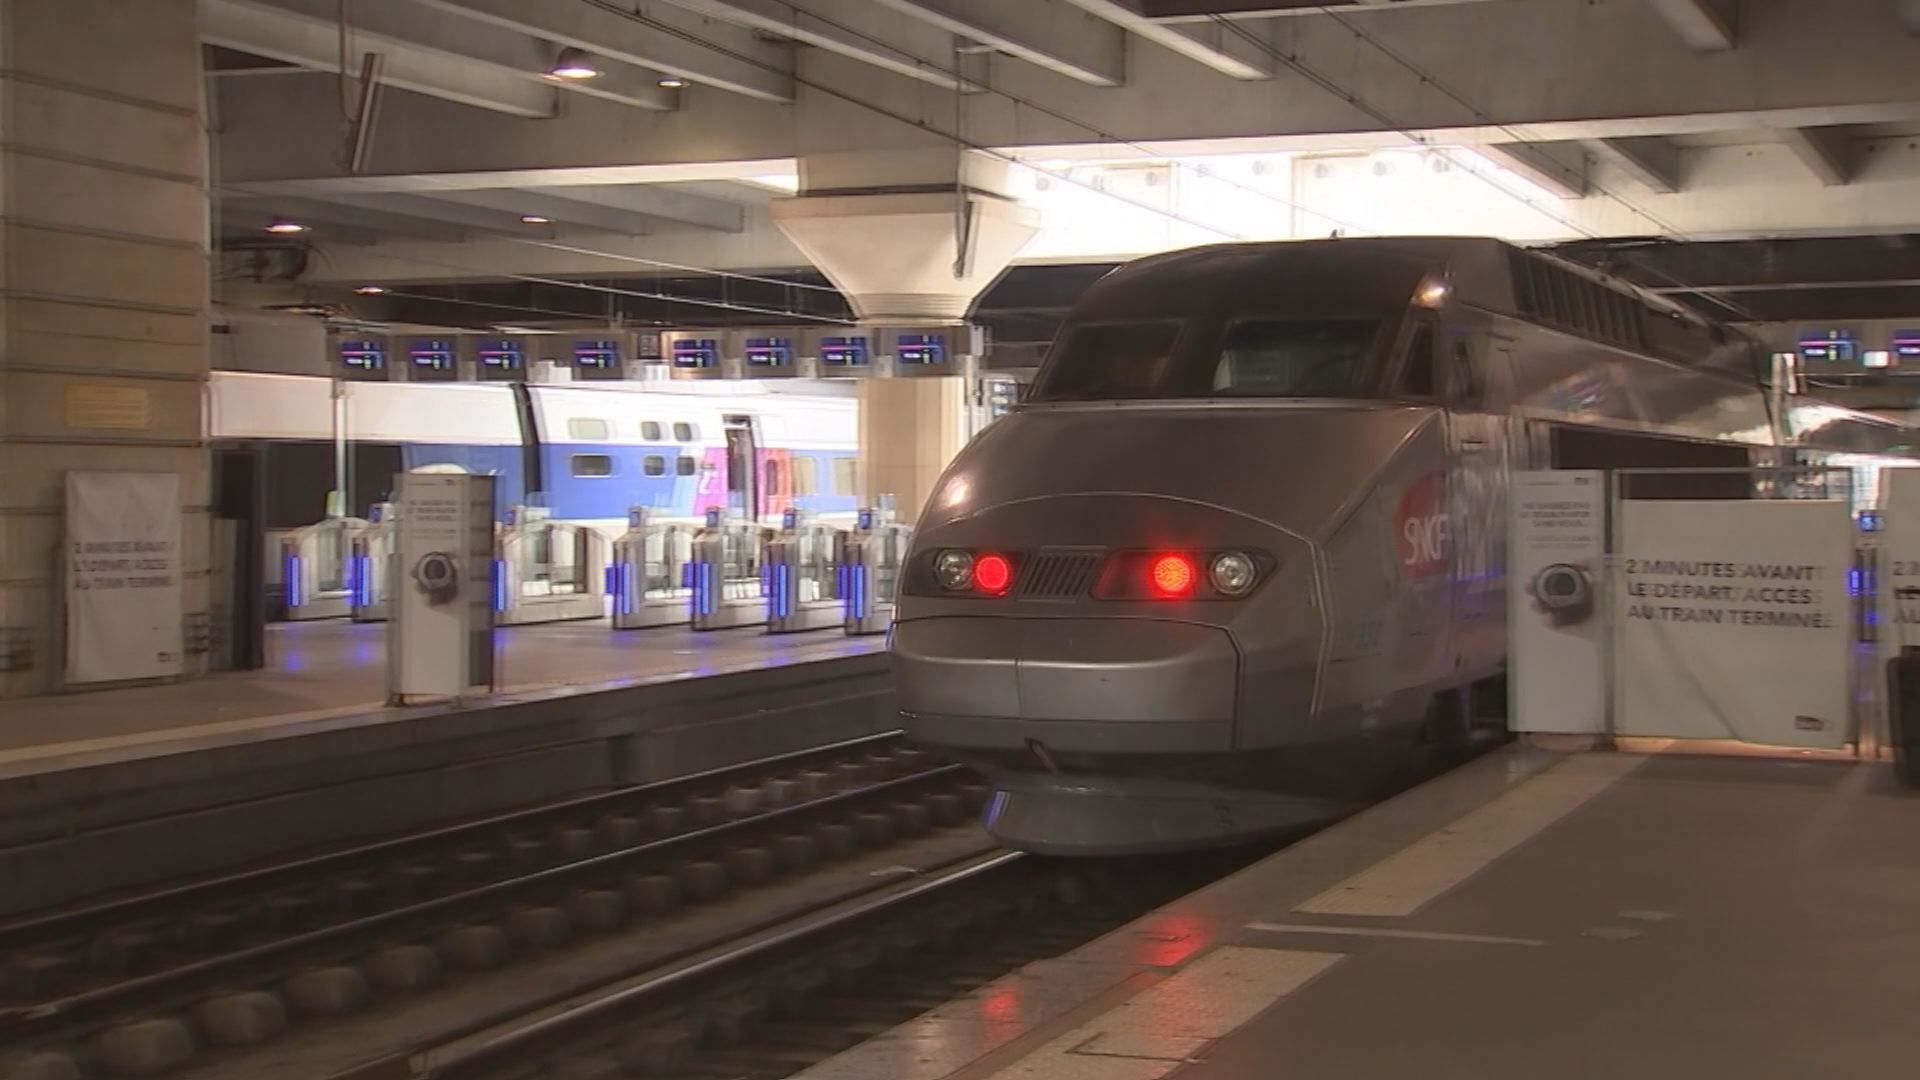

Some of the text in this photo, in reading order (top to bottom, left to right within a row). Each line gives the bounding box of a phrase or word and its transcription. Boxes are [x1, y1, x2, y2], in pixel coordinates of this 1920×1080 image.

[1626, 559, 1818, 581] 2 MINUTES AVANT
[1627, 581, 1647, 597] LE
[1628, 604, 1654, 621] AU
[1660, 606, 1722, 624] TRAIN
